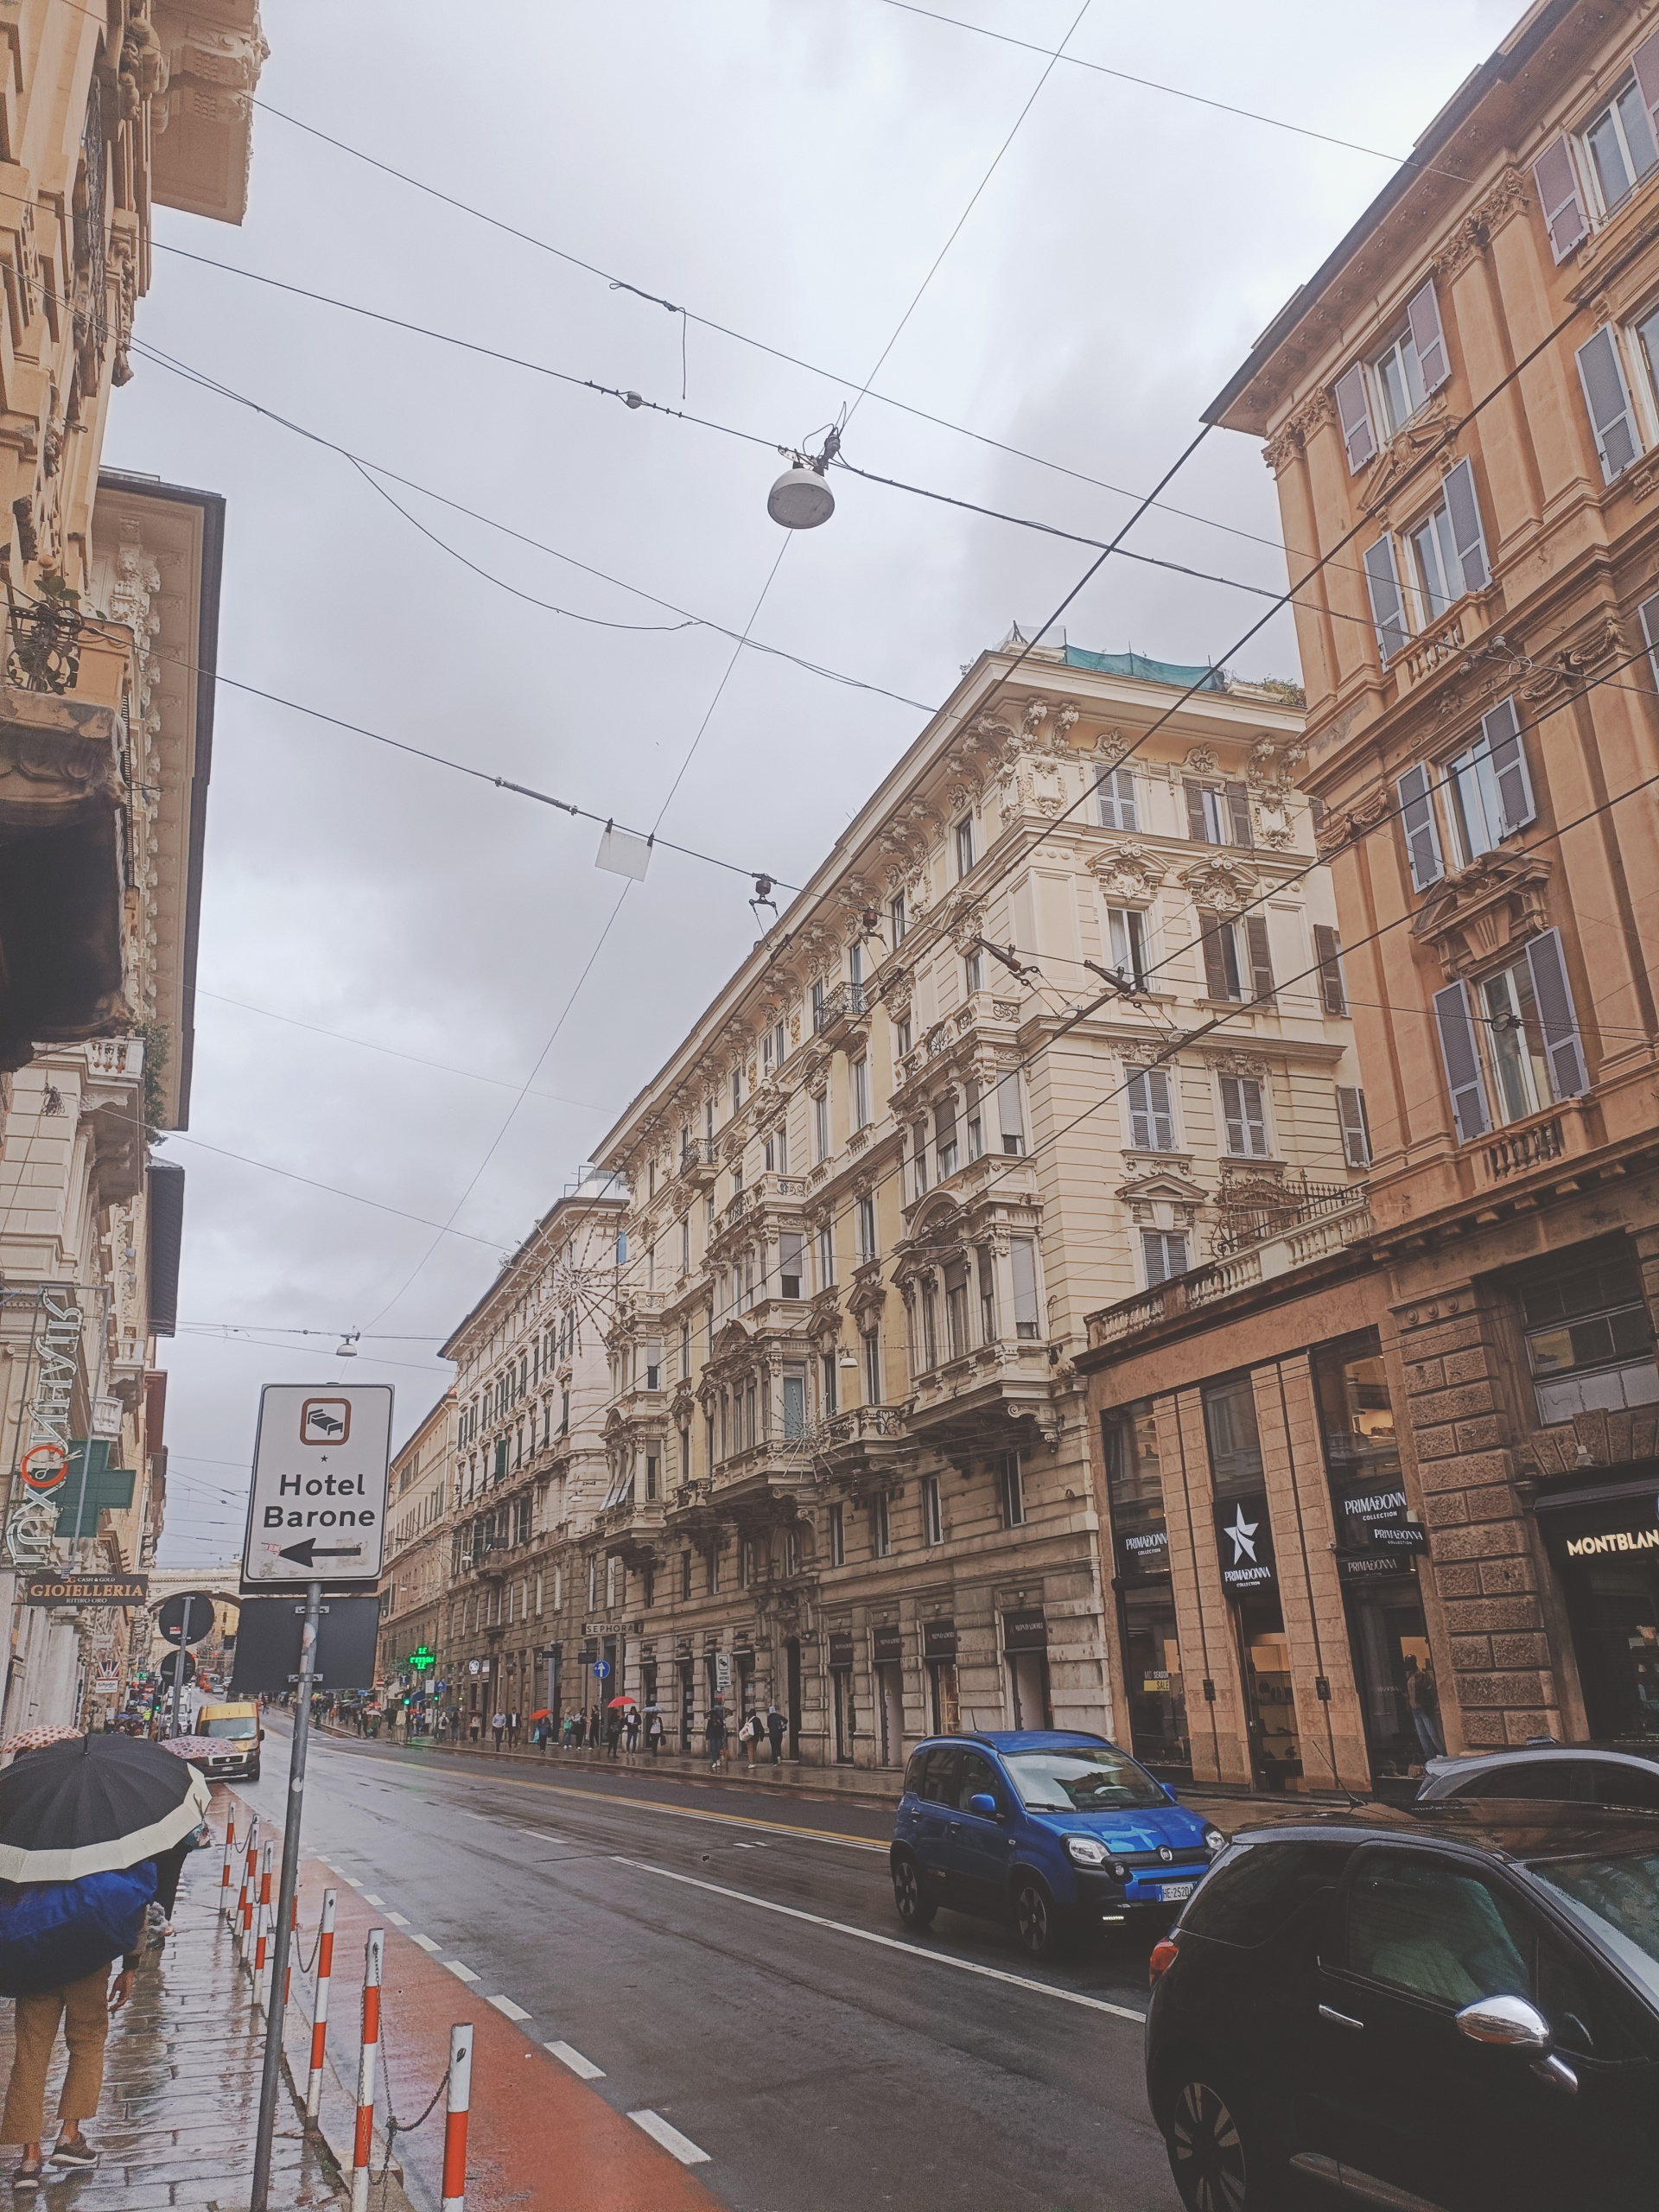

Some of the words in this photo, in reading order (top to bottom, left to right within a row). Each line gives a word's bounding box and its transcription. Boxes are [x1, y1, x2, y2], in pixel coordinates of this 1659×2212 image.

[279, 1474, 365, 1496] Hotel
[264, 1506, 375, 1528] Barone
[1363, 1511, 1397, 1521] COLLECTION
[1374, 1529, 1423, 1541] PRIMADONNA
[1567, 1529, 1659, 1556] MONTBLAN
[1348, 1559, 1397, 1573] PRIMADONNA
[1224, 1567, 1271, 1582] PRIMADONNA
[30, 1585, 143, 1597] GIOIELLERIA
[587, 1624, 634, 1633] SEPHORA
[1156, 1681, 1169, 1690] SALE
